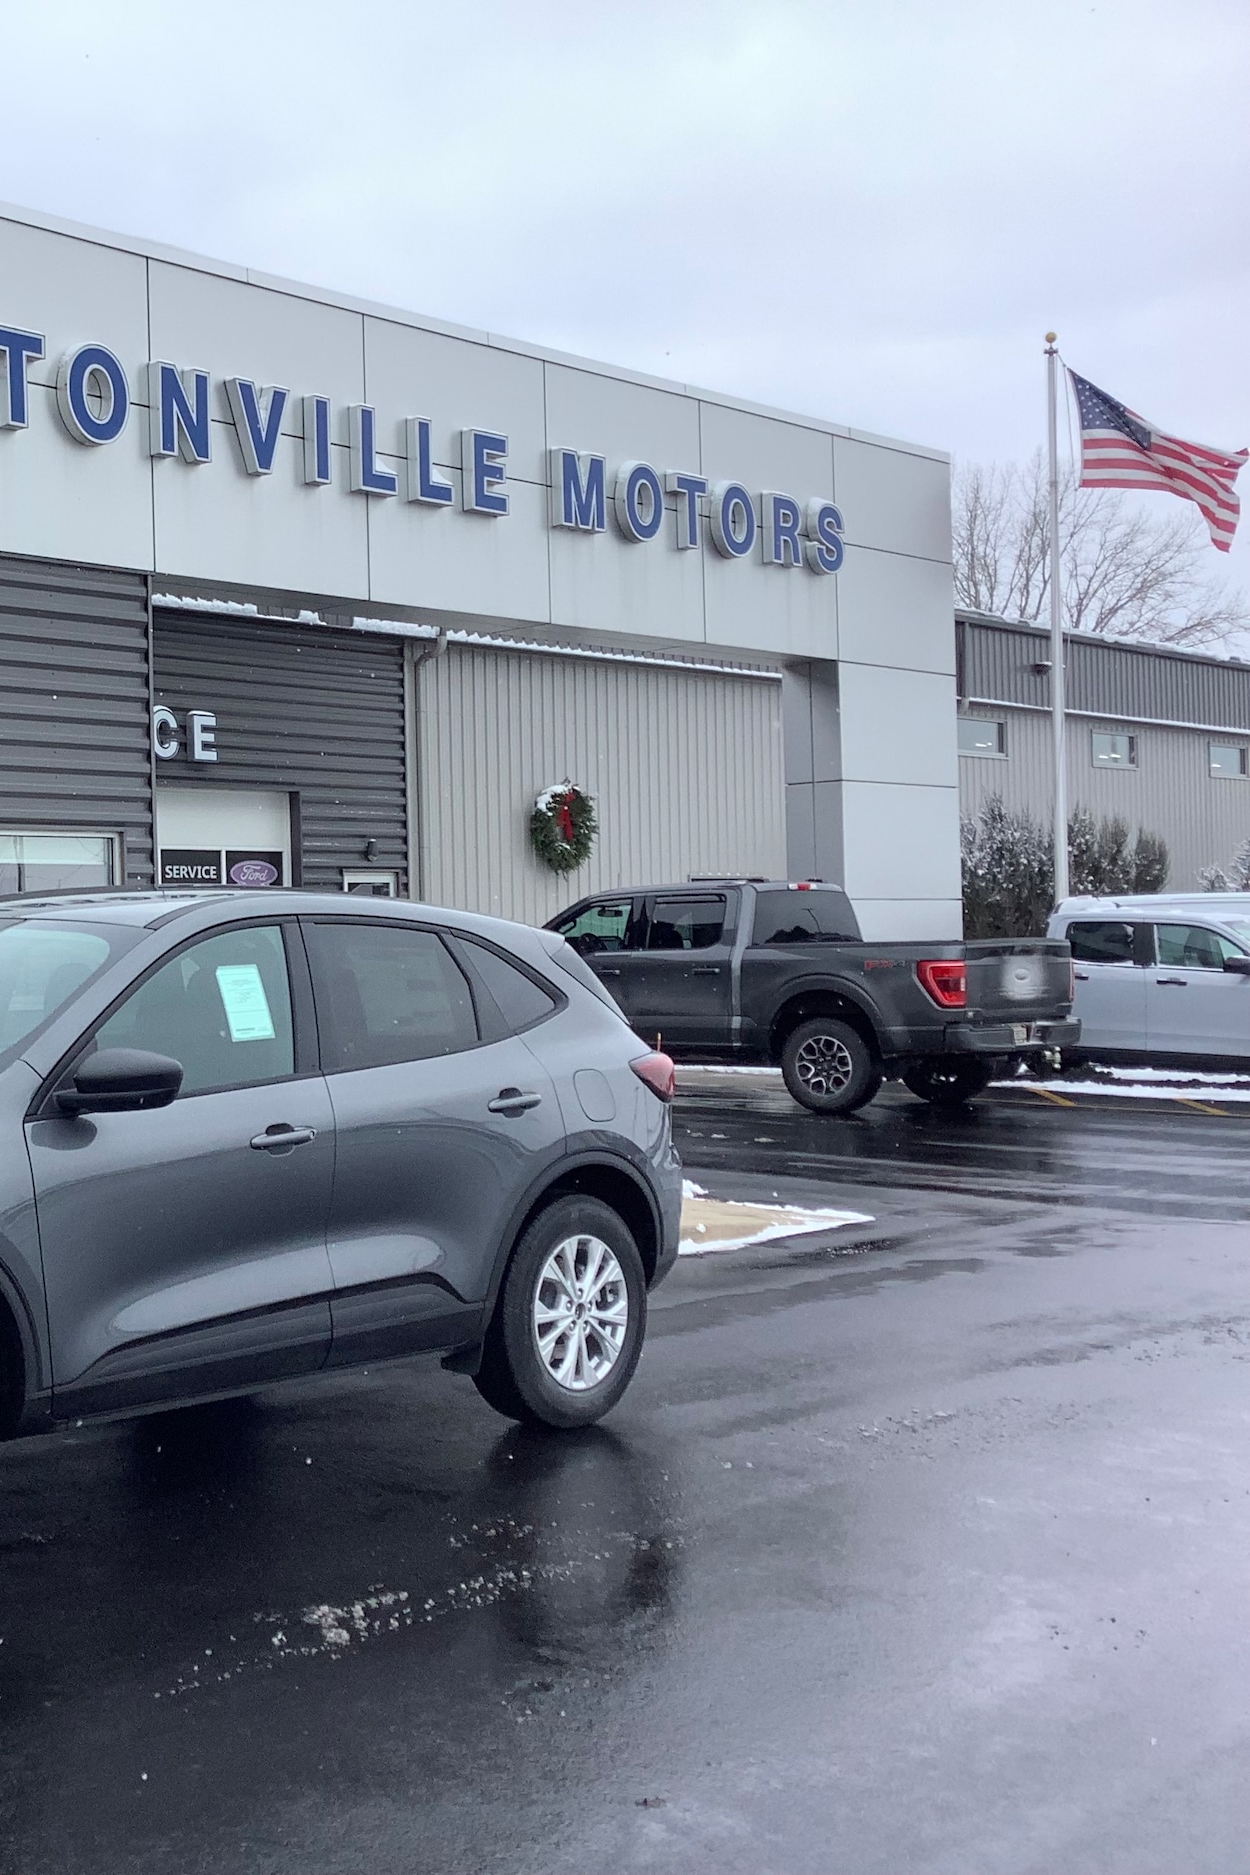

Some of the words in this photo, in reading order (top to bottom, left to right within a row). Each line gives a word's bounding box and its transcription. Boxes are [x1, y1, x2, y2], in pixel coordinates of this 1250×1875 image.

[551, 446, 846, 575] MOTORS
[153, 706, 218, 762] CE
[165, 865, 217, 880] SERVICE
[240, 864, 269, 881] Ford
